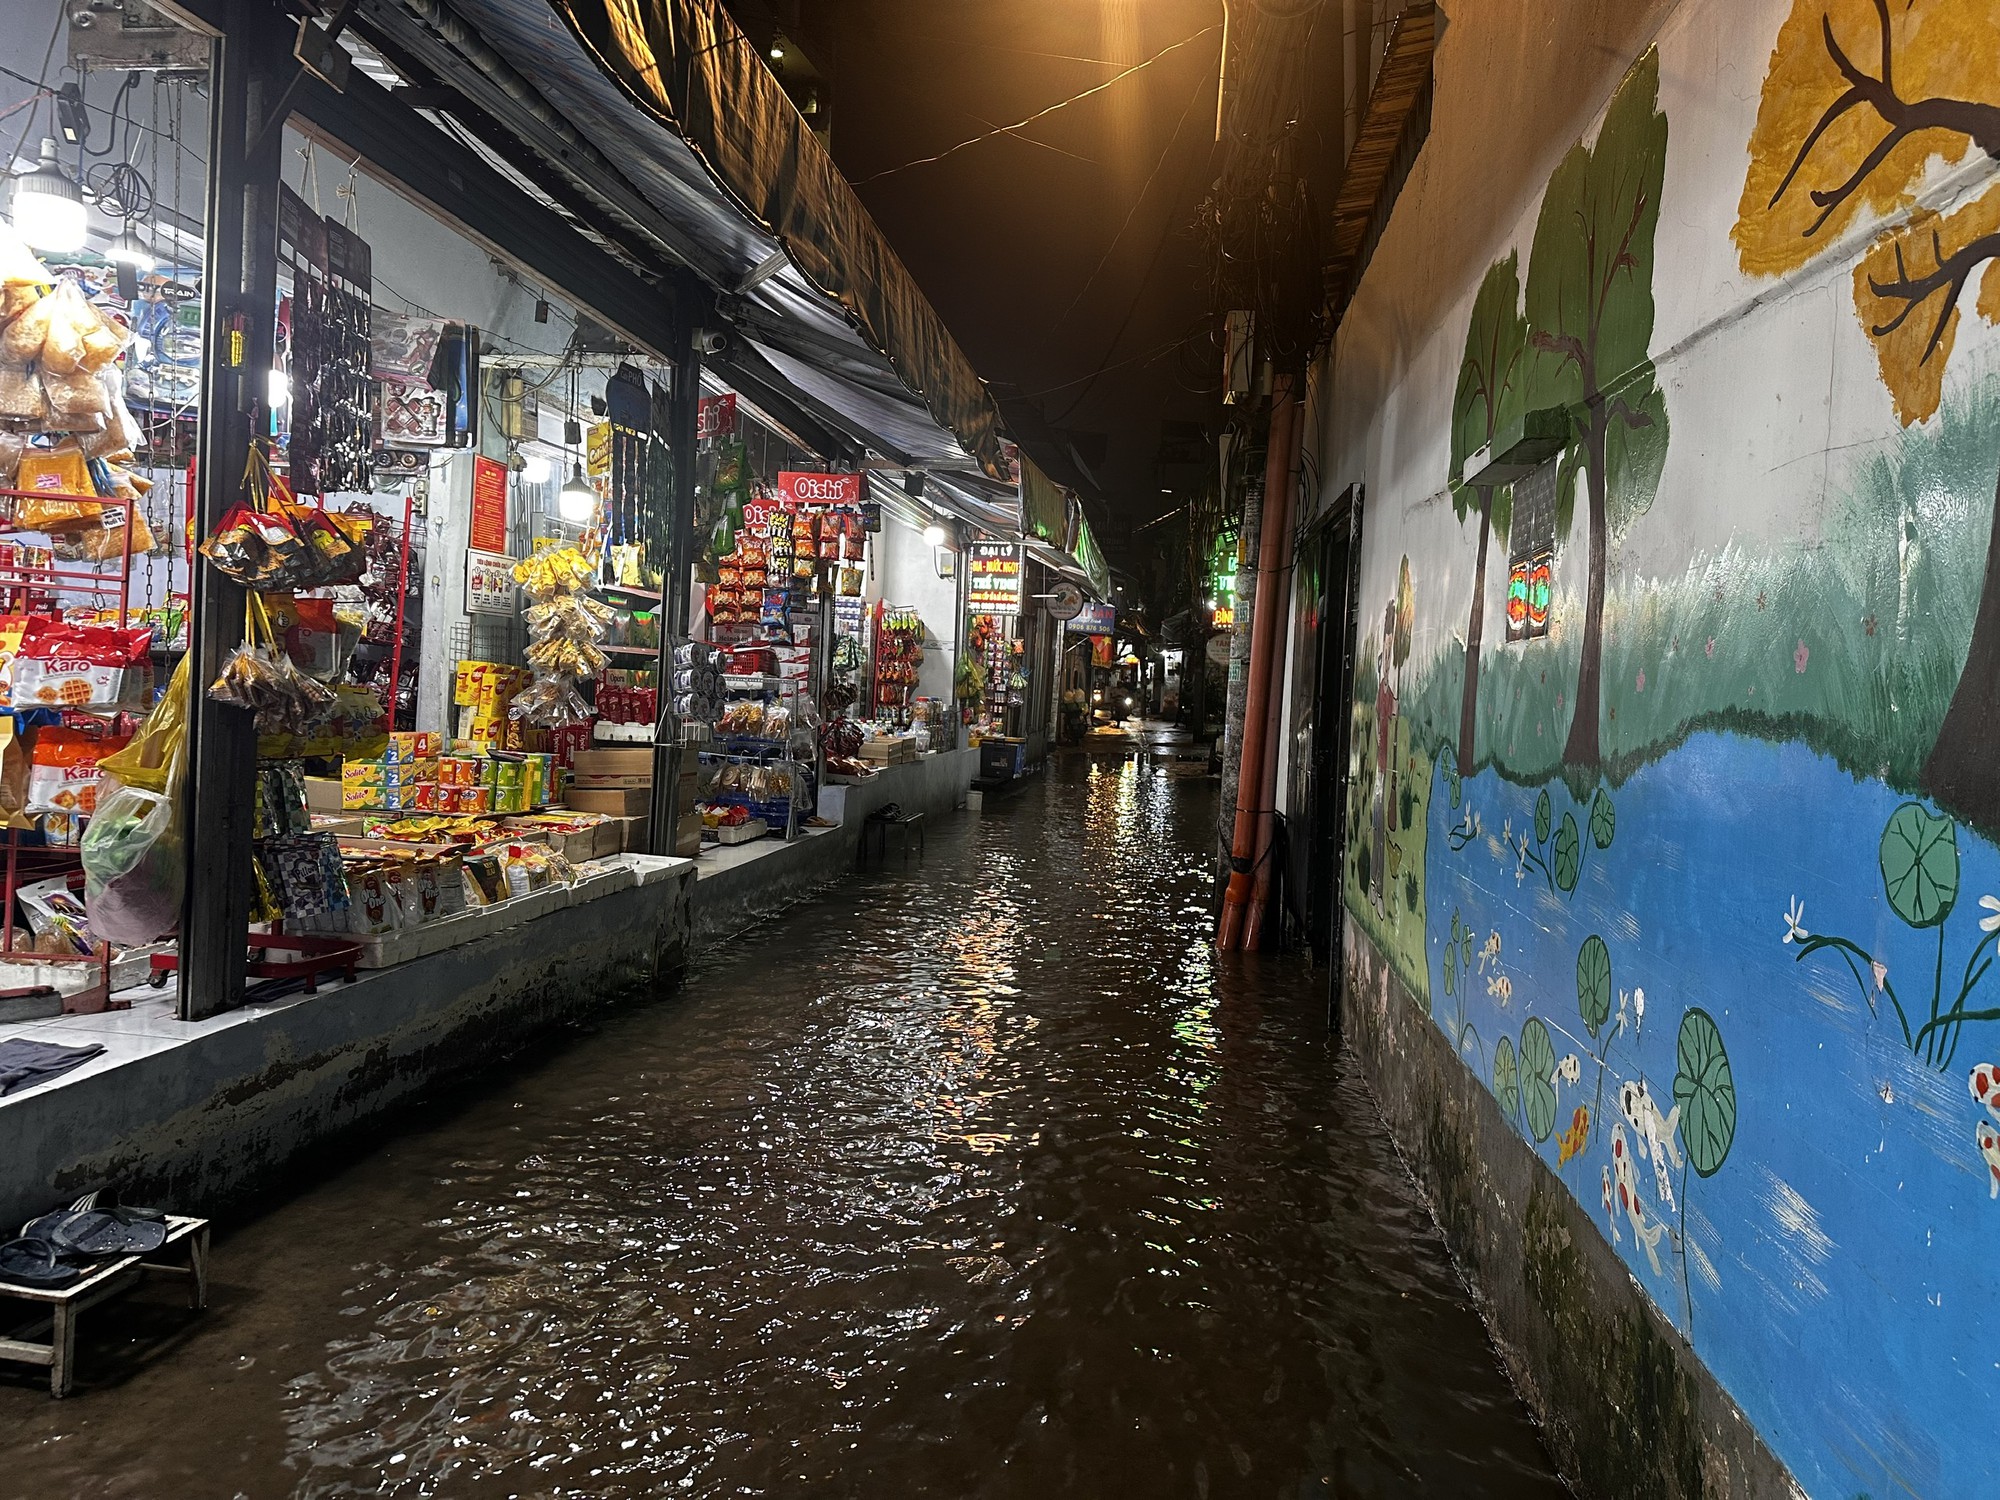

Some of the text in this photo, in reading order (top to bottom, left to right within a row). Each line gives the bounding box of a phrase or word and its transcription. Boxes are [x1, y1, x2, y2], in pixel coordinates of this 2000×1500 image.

[795, 478, 844, 500] Oishi
[980, 544, 1013, 557] ĐẠI LÝ
[44, 657, 91, 675] Karo
[343, 767, 366, 779] Solite
[343, 789, 367, 802] Solite
